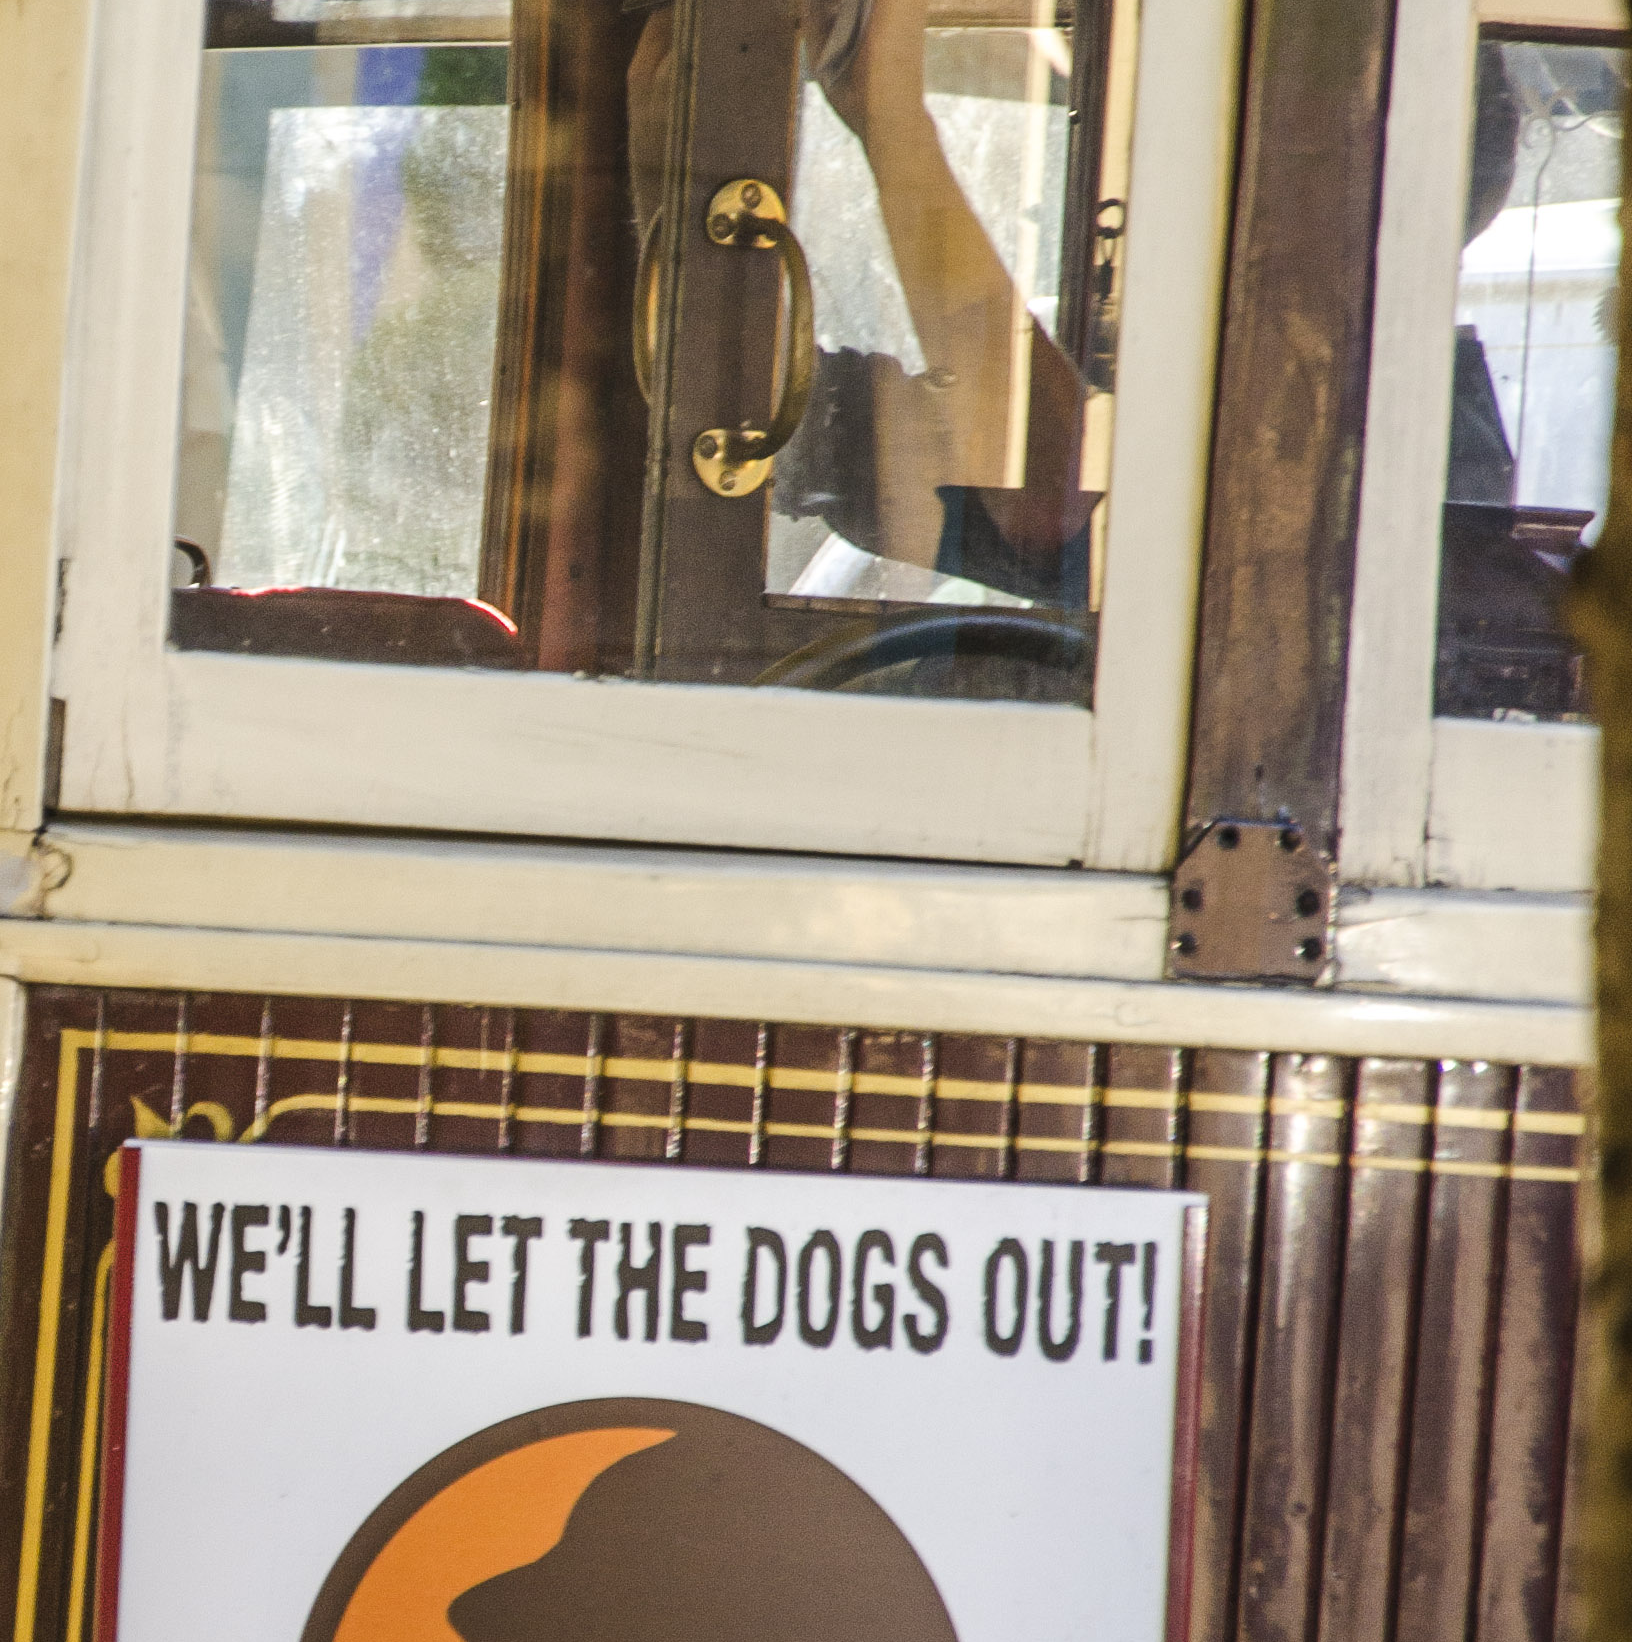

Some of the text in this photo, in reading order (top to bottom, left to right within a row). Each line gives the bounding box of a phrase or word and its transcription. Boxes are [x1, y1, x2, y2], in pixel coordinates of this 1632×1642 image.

[155, 1202, 1156, 1363] WE'LL LET THE DOGS OUT!
